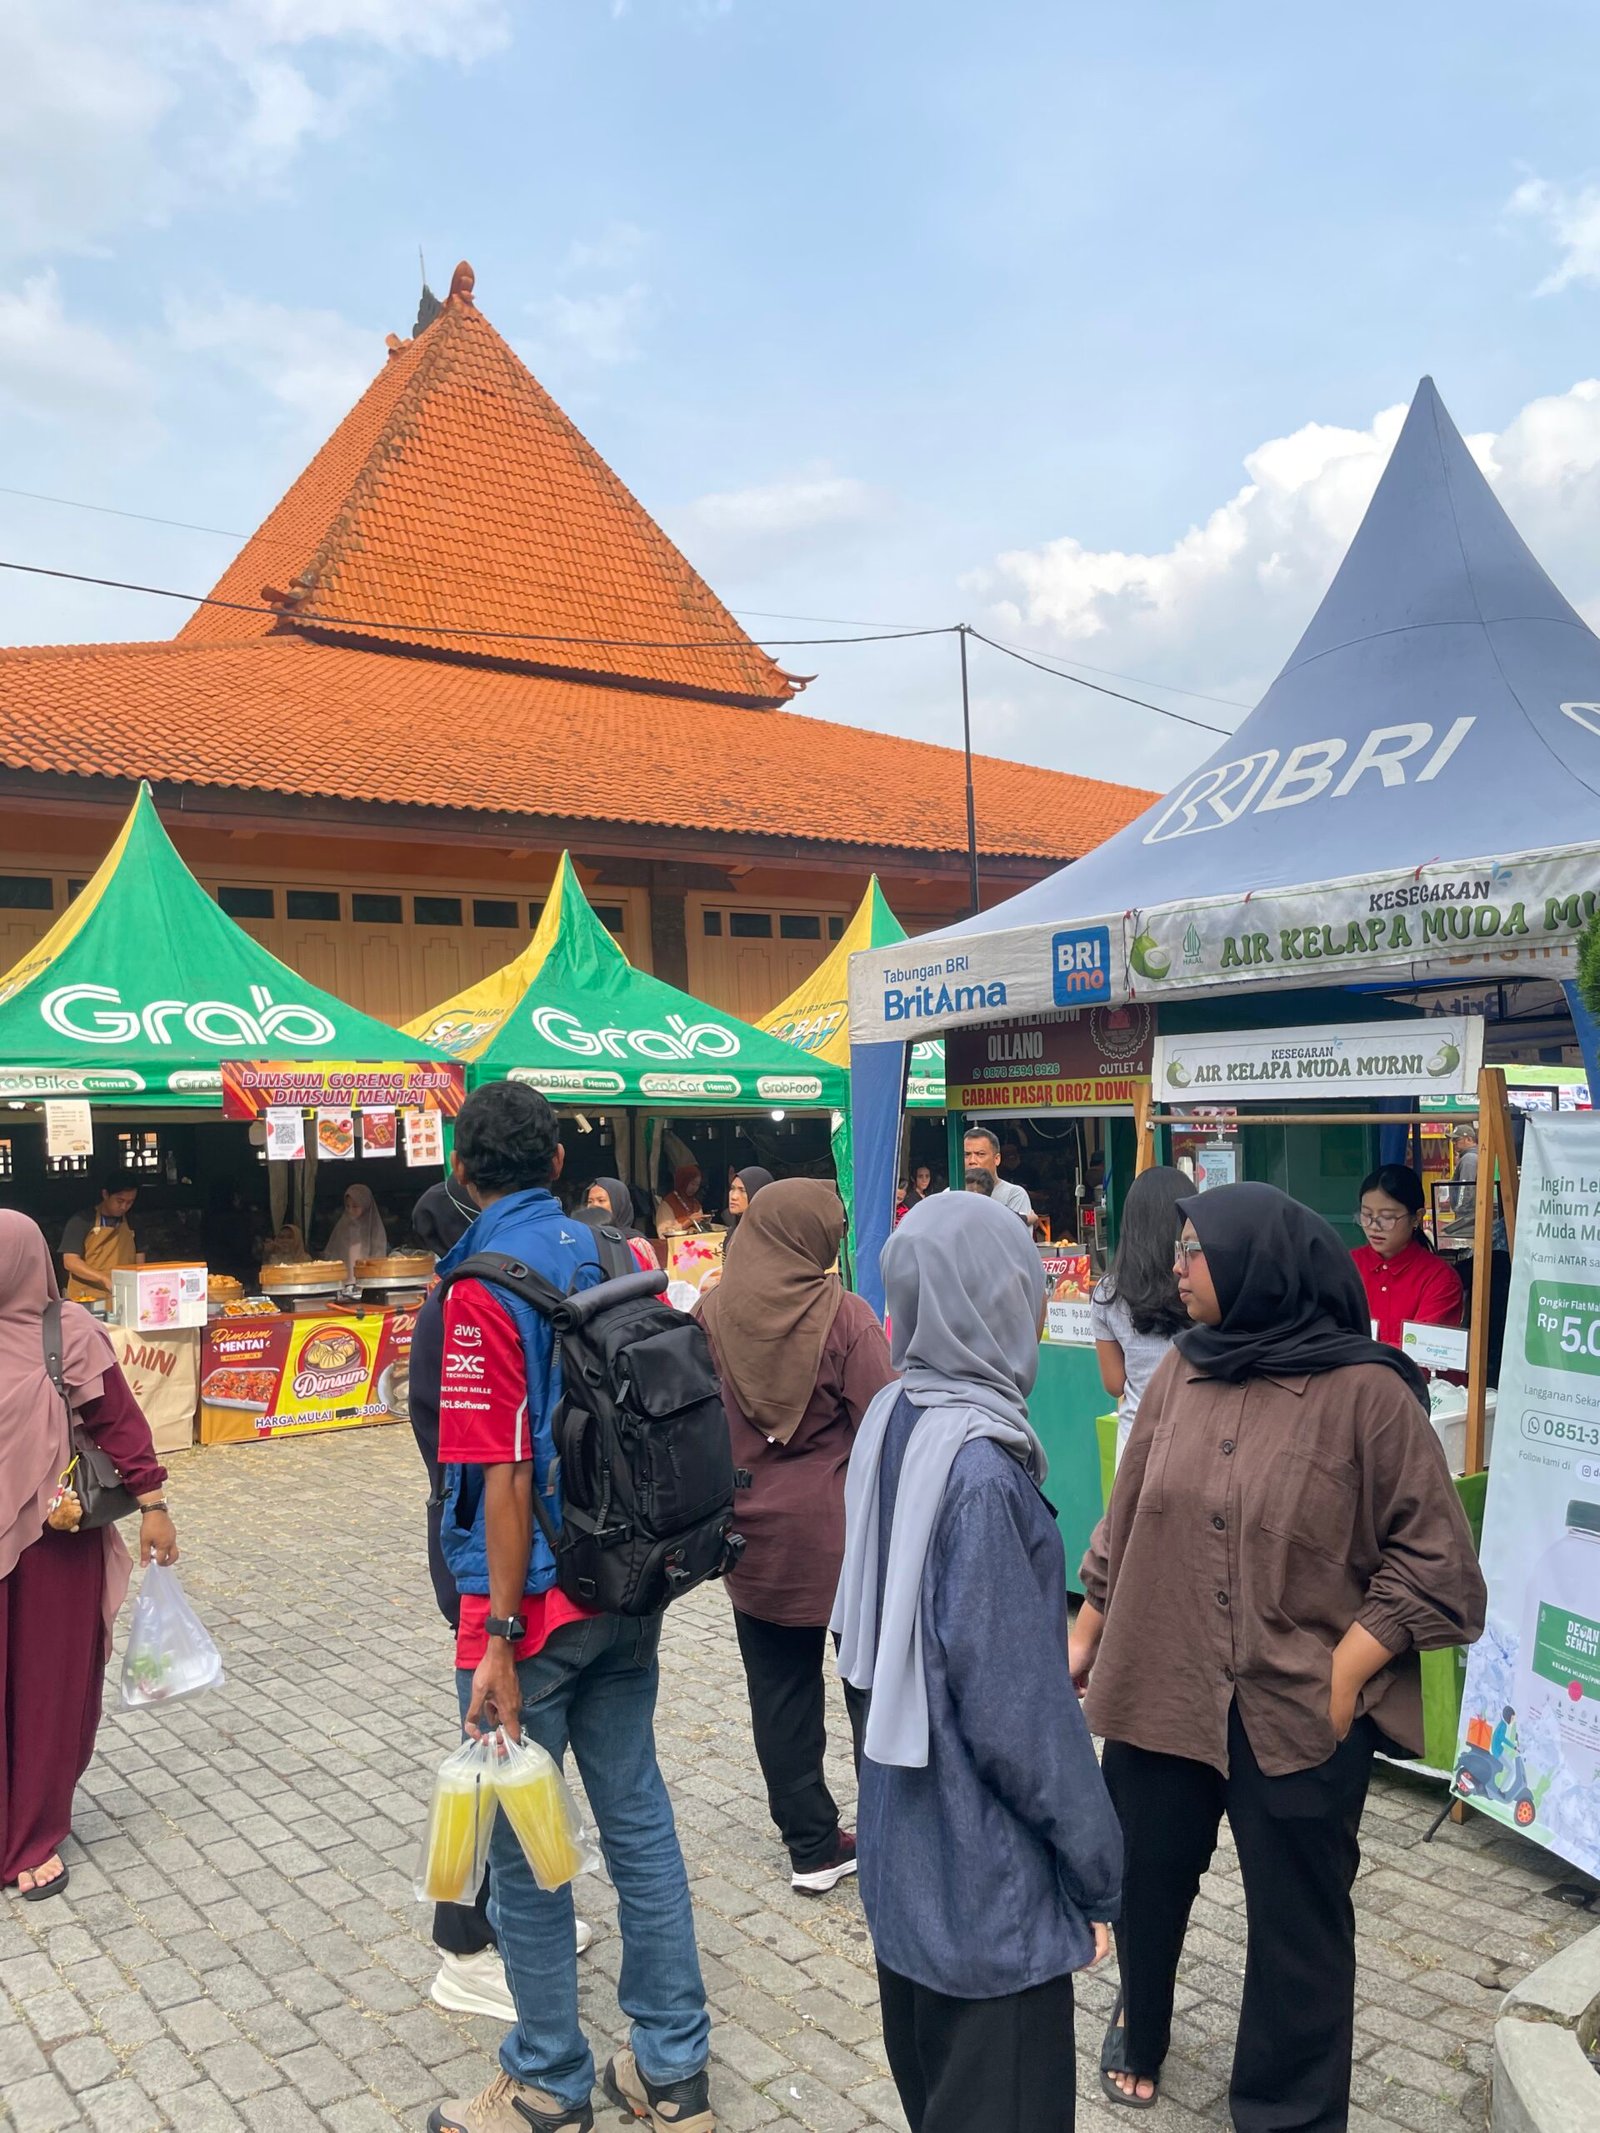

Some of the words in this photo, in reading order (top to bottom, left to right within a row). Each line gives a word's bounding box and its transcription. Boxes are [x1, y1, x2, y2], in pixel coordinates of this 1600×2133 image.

[1253, 716, 1477, 813] BRI
[1369, 882, 1490, 911] KESEGARAN
[1221, 933, 1273, 967] AIR
[1280, 915, 1412, 960] KELAPA
[1423, 903, 1529, 944] MUDA
[1058, 941, 1100, 972] BRI
[883, 962, 942, 984] Tabungan
[946, 956, 969, 973] BRI
[1067, 969, 1104, 992] mo
[884, 981, 1007, 1022] BritAma
[40, 983, 336, 1046] Grab
[532, 1006, 741, 1059] Grab
[988, 1031, 1043, 1061] OLLANO
[1272, 1046, 1333, 1060] KESEGARAN
[984, 1066, 1007, 1078] 0878
[1009, 1065, 1033, 1077] 2594
[1034, 1063, 1060, 1075] 9926
[1099, 1062, 1135, 1075] OUTLET
[1137, 1062, 1144, 1072] 4
[1195, 1062, 1222, 1083] AIR
[1227, 1059, 1292, 1081] KELAPA
[1297, 1057, 1350, 1079] MUDA
[1356, 1055, 1422, 1077] MURNI
[89, 1080, 130, 1089] Hemat
[242, 1072, 323, 1088] DIMSUM
[329, 1073, 404, 1088] GORENG
[408, 1073, 451, 1088] KEJU
[587, 1079, 616, 1090] Hemat
[704, 1082, 733, 1094] Hemat
[762, 1081, 818, 1095] GrabFood
[907, 1083, 925, 1095] ike
[272, 1089, 351, 1105] DIMSUM
[355, 1089, 426, 1105] MENTAI
[962, 1087, 1009, 1106] CABANG
[1013, 1084, 1053, 1104] PASAR
[1541, 1176, 1574, 1196] Ingin
[1539, 1199, 1589, 1217] Minum
[1536, 1222, 1576, 1239] Muda
[1531, 1252, 1556, 1264] Kami
[1558, 1255, 1587, 1267] ANTAR
[1050, 1308, 1067, 1317] PASTEL
[1539, 1296, 1570, 1309] Ongkir
[1571, 1300, 1586, 1311] Flat
[454, 1324, 481, 1338] aws
[1537, 1313, 1558, 1332] Rp
[211, 1328, 273, 1343] Dimsum
[220, 1339, 264, 1353] MENTAI
[123, 1343, 177, 1377] MINI
[446, 1354, 485, 1374] DXC
[293, 1367, 369, 1399] Dimsum
[470, 1386, 492, 1394] MILLE
[1524, 1384, 1573, 1402] Langganan
[255, 1415, 296, 1428] HARGA
[297, 1410, 333, 1425] MULAI
[1544, 1420, 1599, 1445] 0851-3
[1519, 1450, 1541, 1463] Follow
[1543, 1456, 1559, 1467] kami
[1562, 1461, 1571, 1470] di
[1565, 1635, 1597, 1657] SEHATI
[1552, 1661, 1572, 1674] KELAPA
